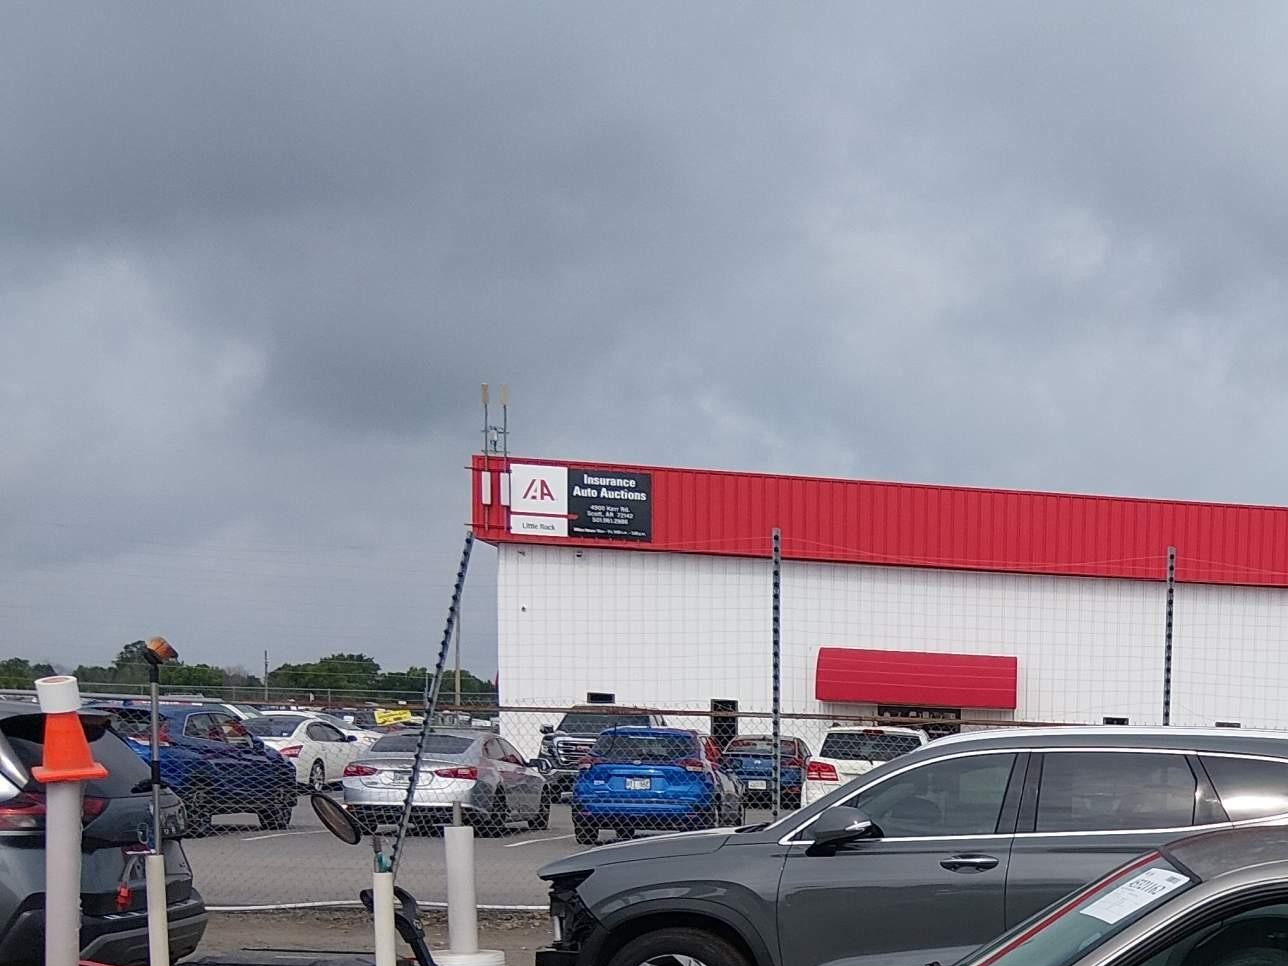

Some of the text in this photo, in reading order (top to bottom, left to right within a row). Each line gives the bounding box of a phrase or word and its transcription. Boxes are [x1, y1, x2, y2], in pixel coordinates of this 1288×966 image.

[584, 474, 636, 487] Insurance
[573, 486, 647, 501] Auto Auctions
